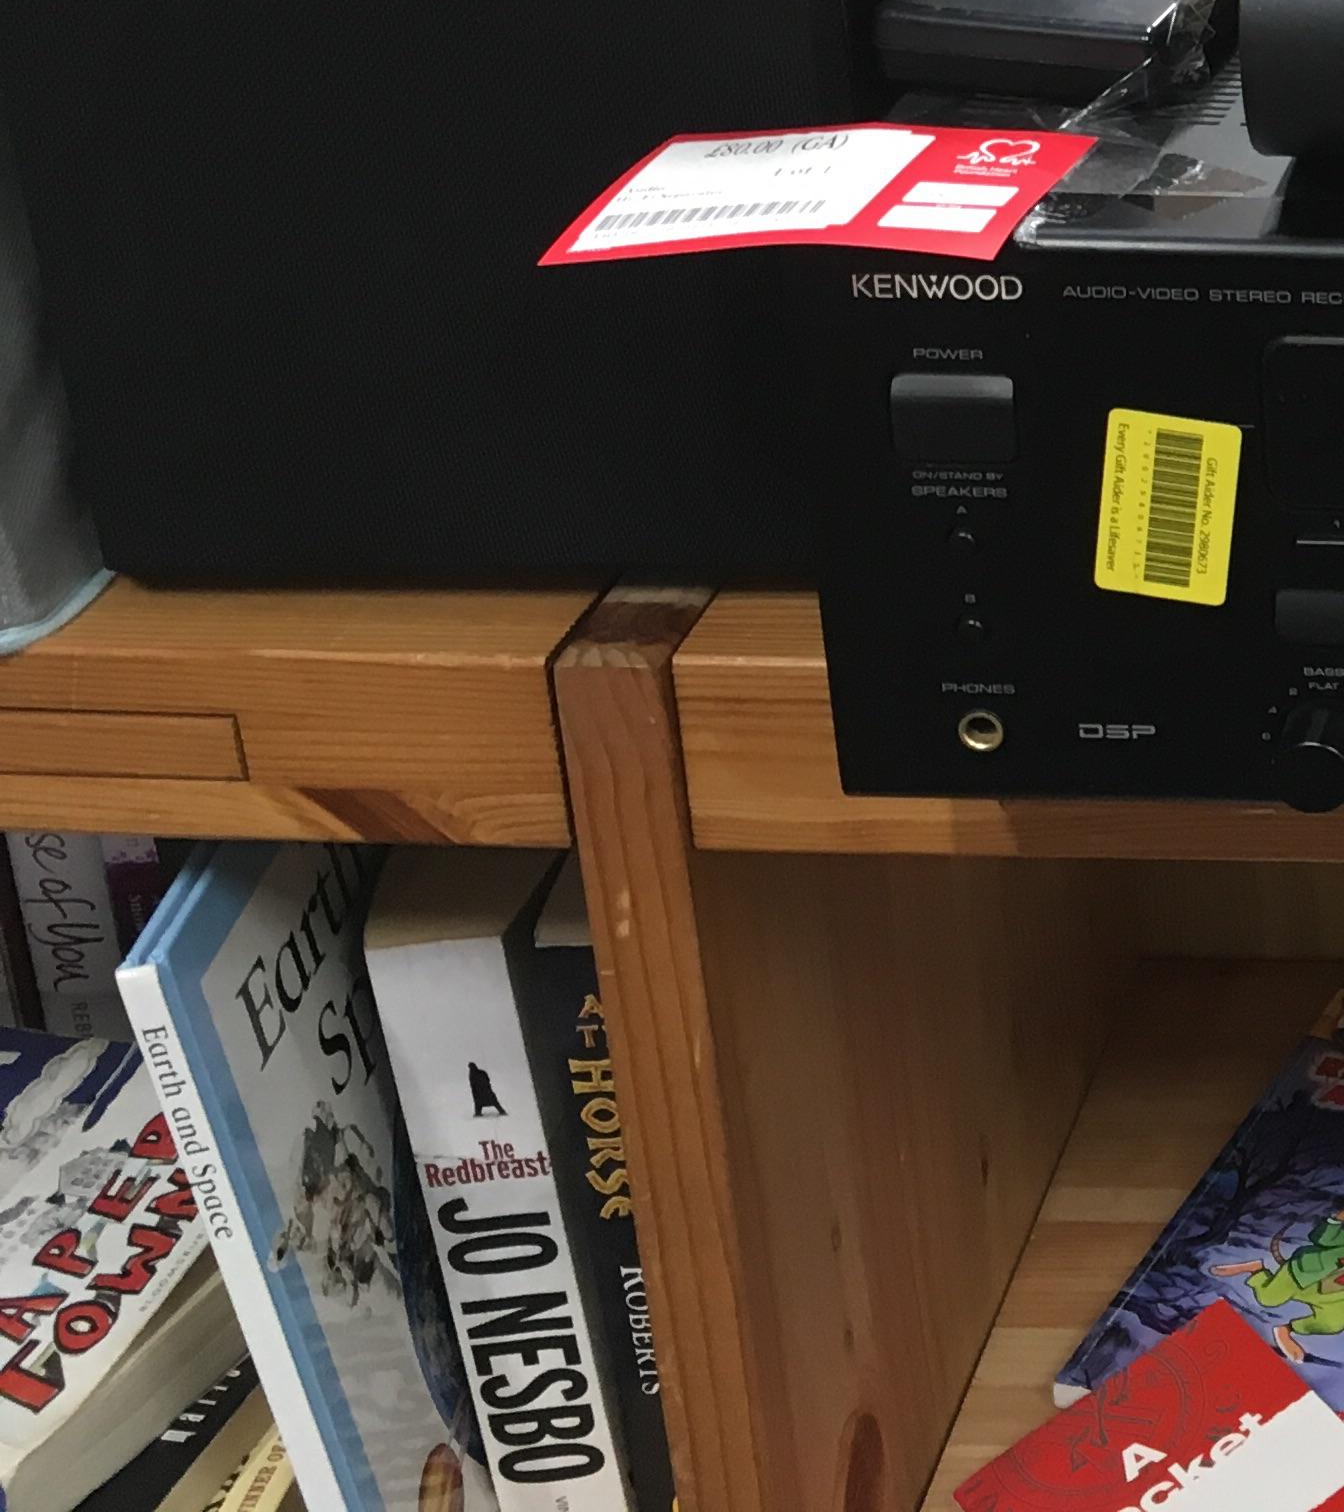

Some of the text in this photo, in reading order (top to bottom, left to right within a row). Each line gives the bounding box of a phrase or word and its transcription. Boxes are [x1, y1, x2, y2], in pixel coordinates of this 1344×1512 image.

[704, 134, 848, 158] £80.00 (GA)
[852, 274, 1023, 301] KENWOOD
[1062, 286, 1199, 302] AUDIO-VIDEO
[1208, 288, 1291, 304] STEREO
[913, 347, 983, 360] POWER
[1114, 423, 1129, 452] Every
[1114, 455, 1126, 474] Gift
[1205, 457, 1218, 477] Gift
[912, 485, 1008, 499] SPEAKERS
[1111, 476, 1124, 504] Aider
[1202, 480, 1215, 508] Aider
[1106, 526, 1120, 571] Lifesaver
[1303, 666, 1344, 677] BASS
[941, 682, 1016, 695] PHONES
[1078, 723, 1157, 739] DSP
[24, 834, 104, 991] se of You
[141, 1024, 234, 1241] Earth and Space
[478, 1139, 515, 1162] The
[424, 1150, 550, 1188] Redbreast
[0, 1112, 179, 1345] APED
[437, 1196, 606, 1484] JO NESBO
[1117, 1412, 1263, 1512] cket
[1122, 1442, 1168, 1482] A
